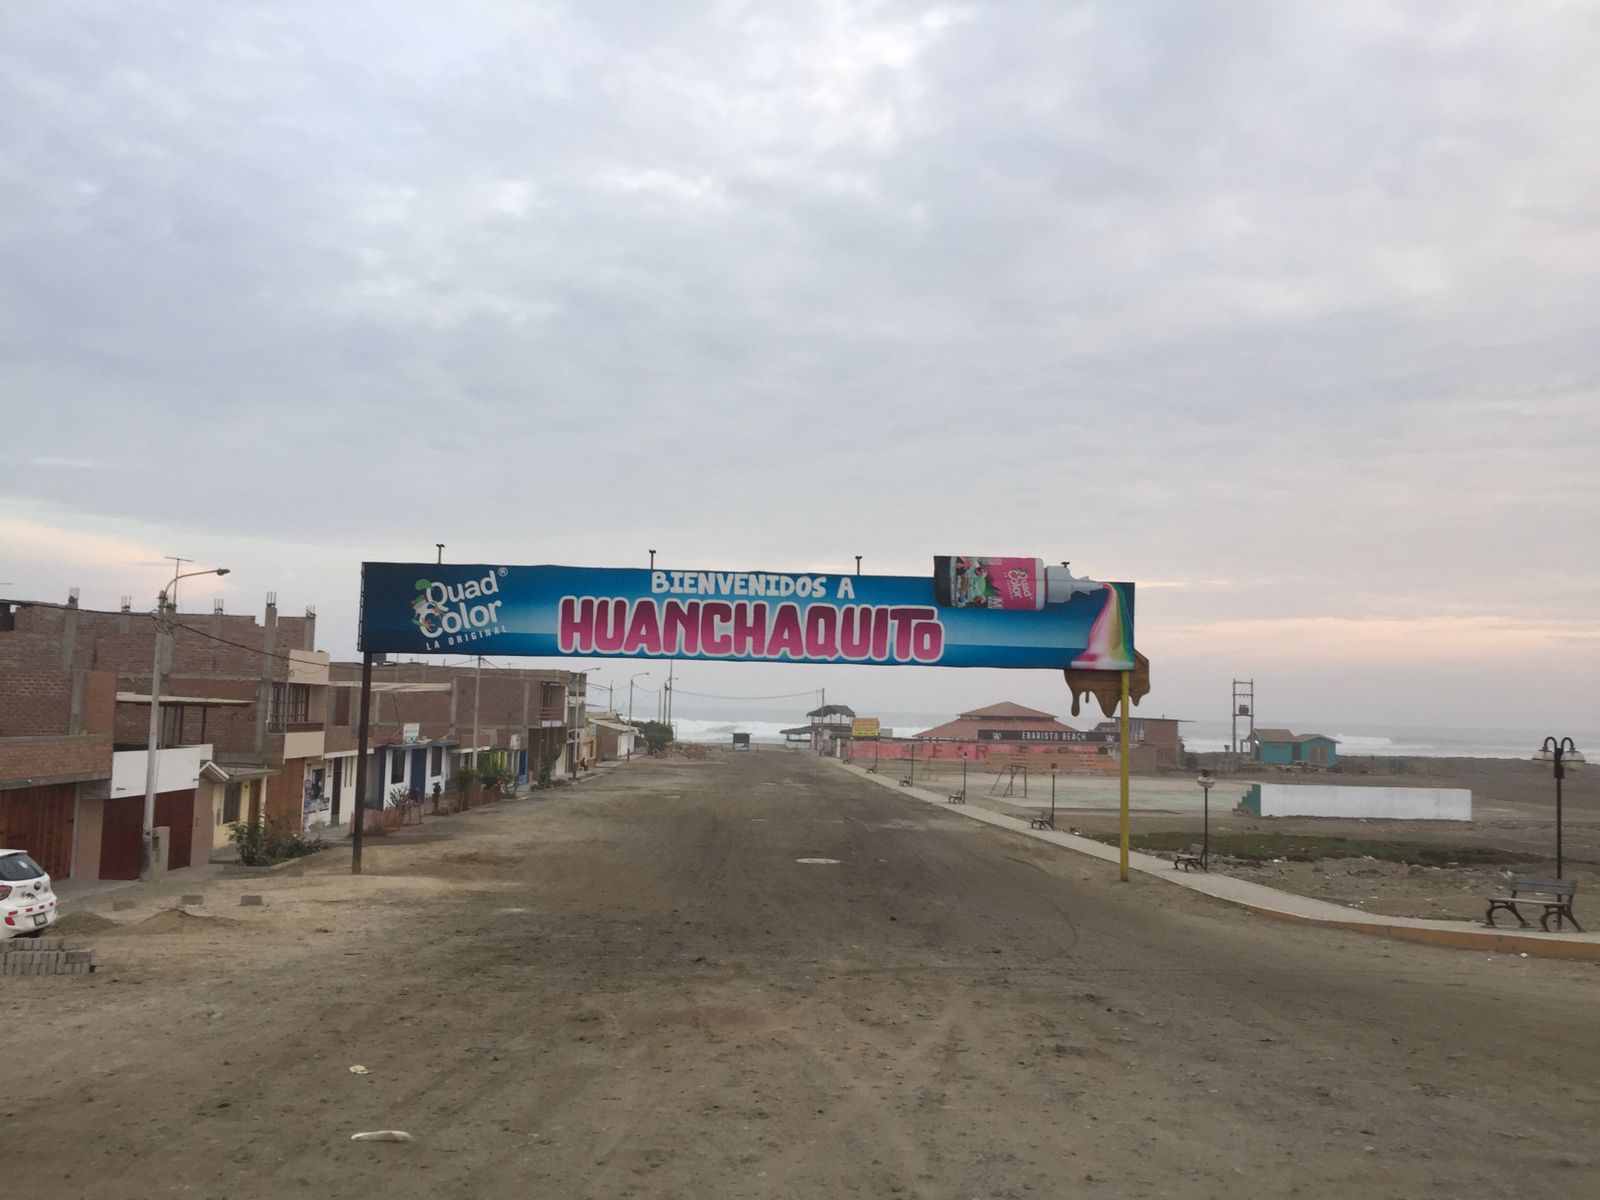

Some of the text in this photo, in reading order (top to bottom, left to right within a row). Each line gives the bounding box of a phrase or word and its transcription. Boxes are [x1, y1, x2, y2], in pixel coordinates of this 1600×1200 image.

[426, 569, 500, 612] Quad
[651, 571, 856, 599] BIENVENIDOS A
[419, 600, 503, 639] Color
[557, 595, 945, 663] HUANCHAQUITO
[425, 625, 507, 651] LA ORIGINAL
[1021, 731, 1087, 741] EBARISTO BEACH
